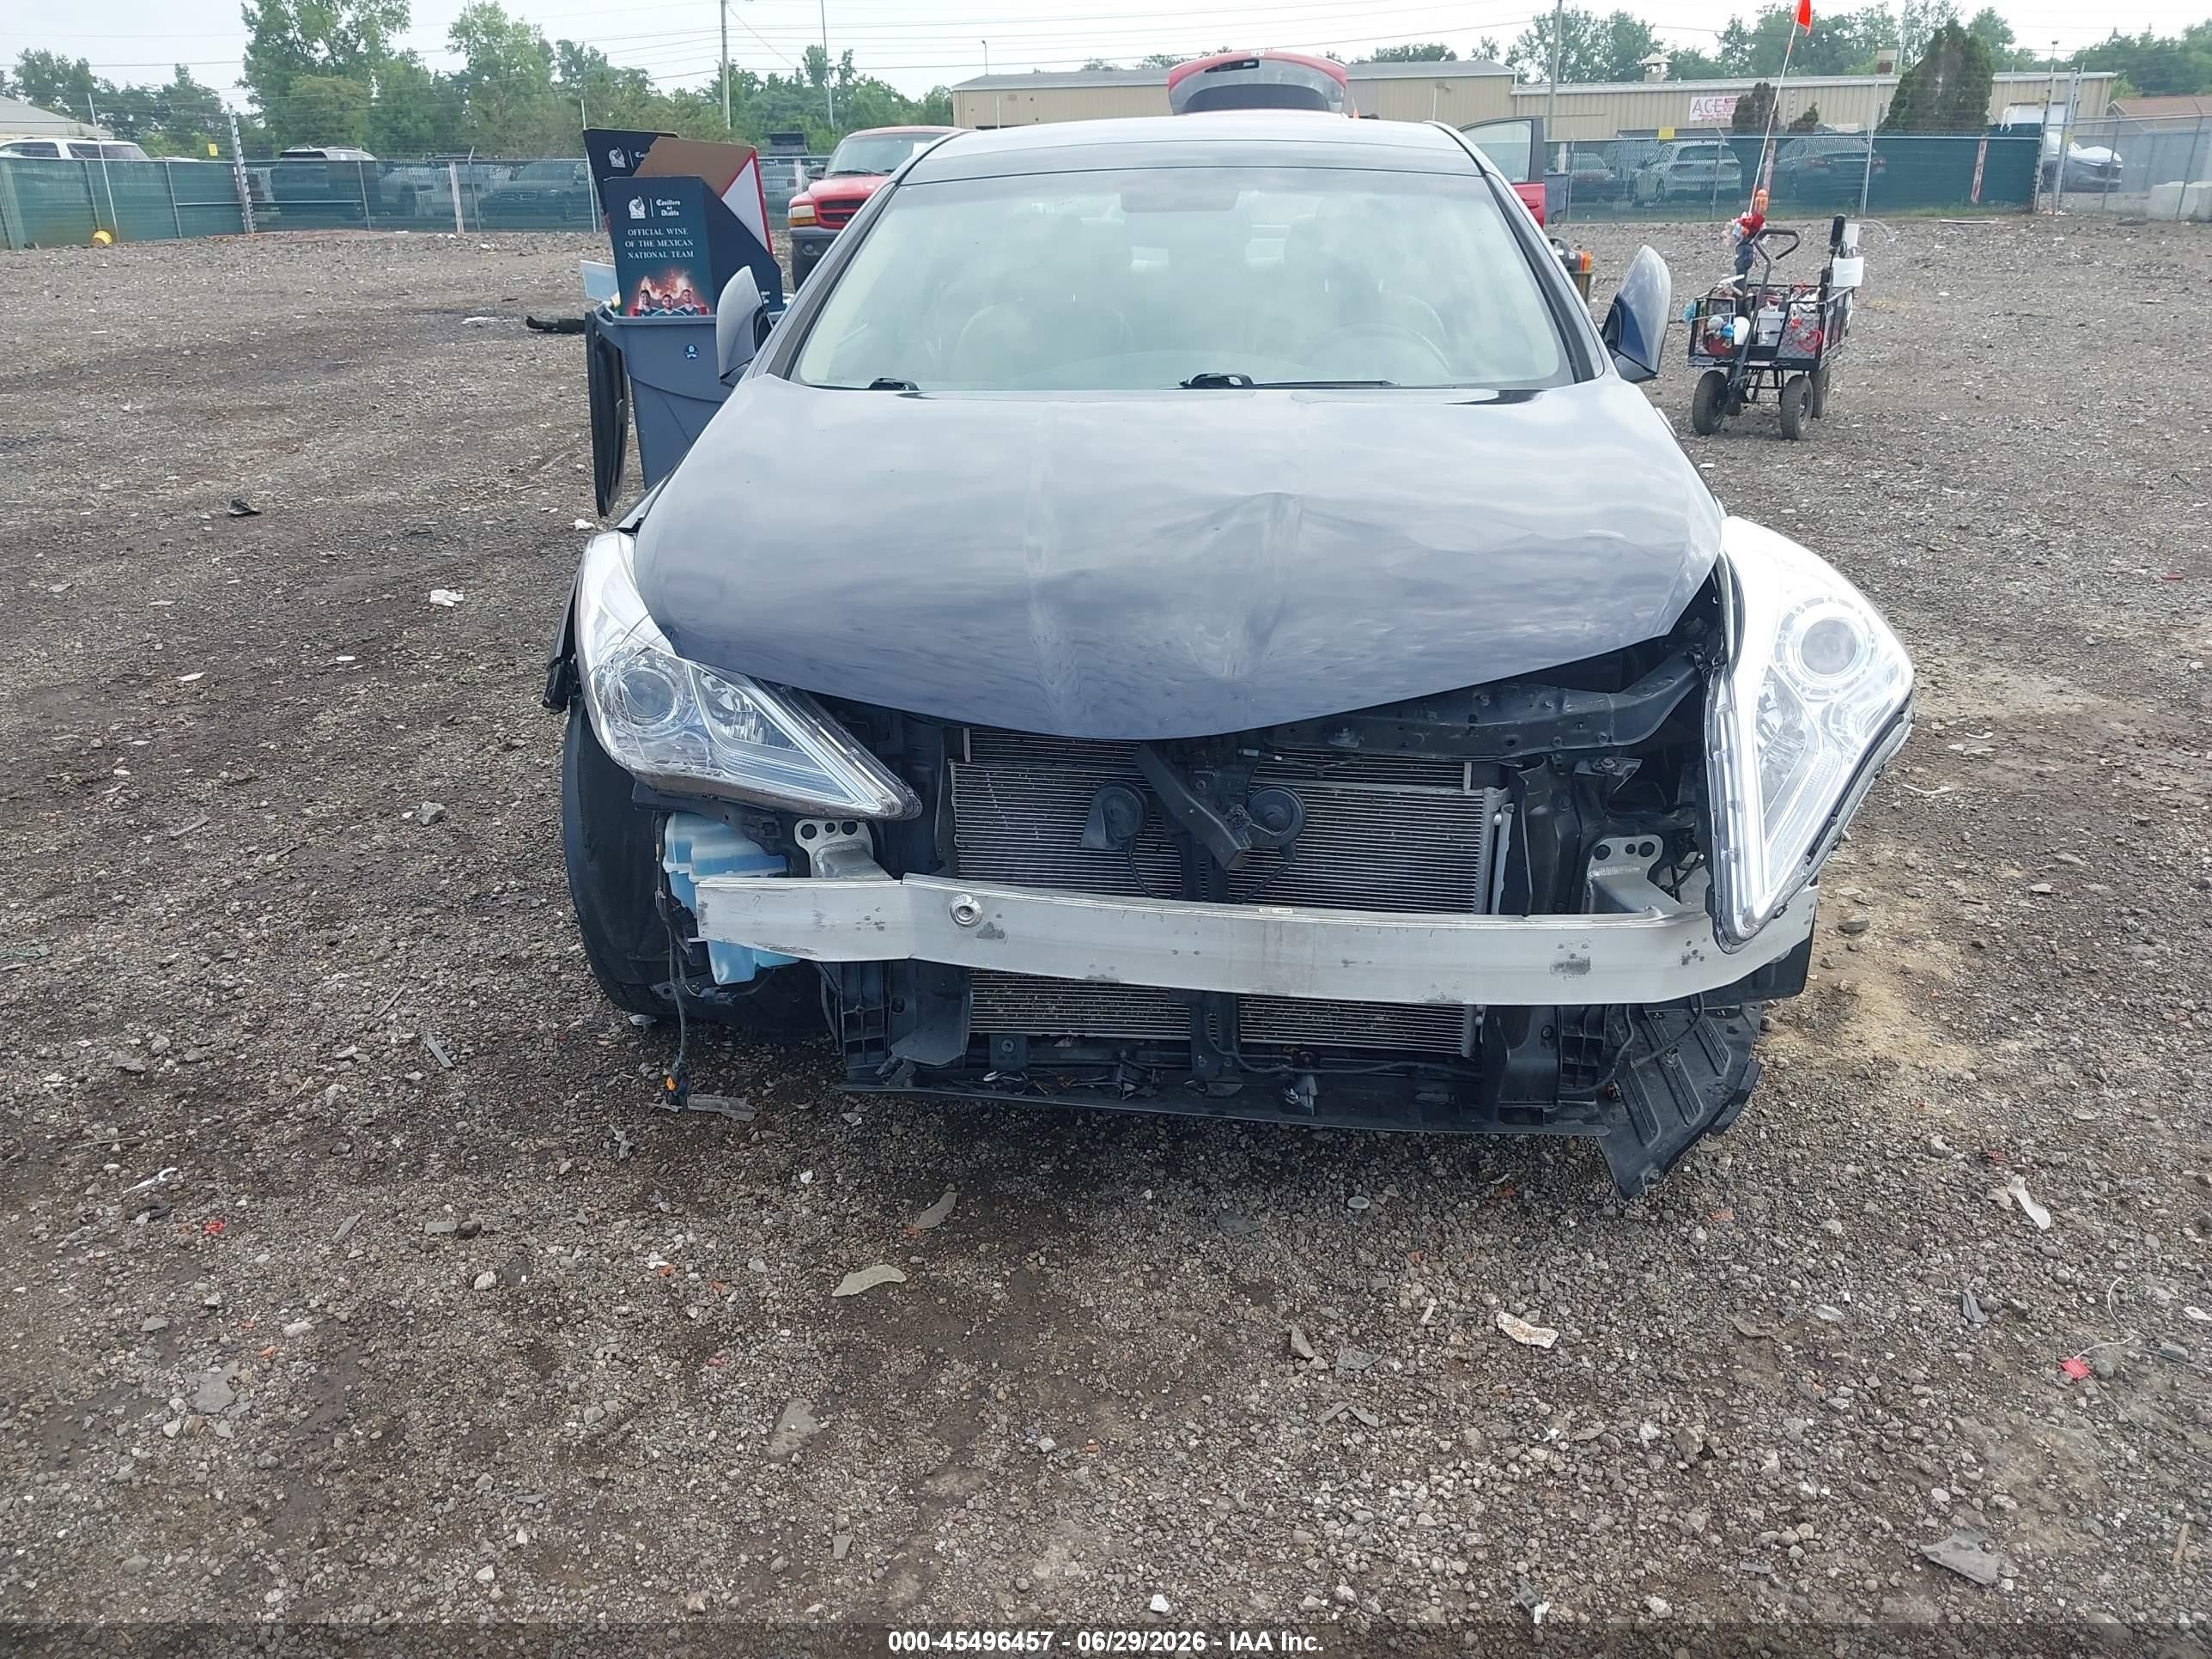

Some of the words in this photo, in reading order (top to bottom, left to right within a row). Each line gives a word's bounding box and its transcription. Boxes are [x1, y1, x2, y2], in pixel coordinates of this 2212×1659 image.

[1692, 98, 1723, 113] ACE
[624, 240, 635, 248] OF
[657, 239, 694, 247] MEXICAN
[627, 251, 669, 259] NATIONAL
[671, 250, 694, 258] TEAM
